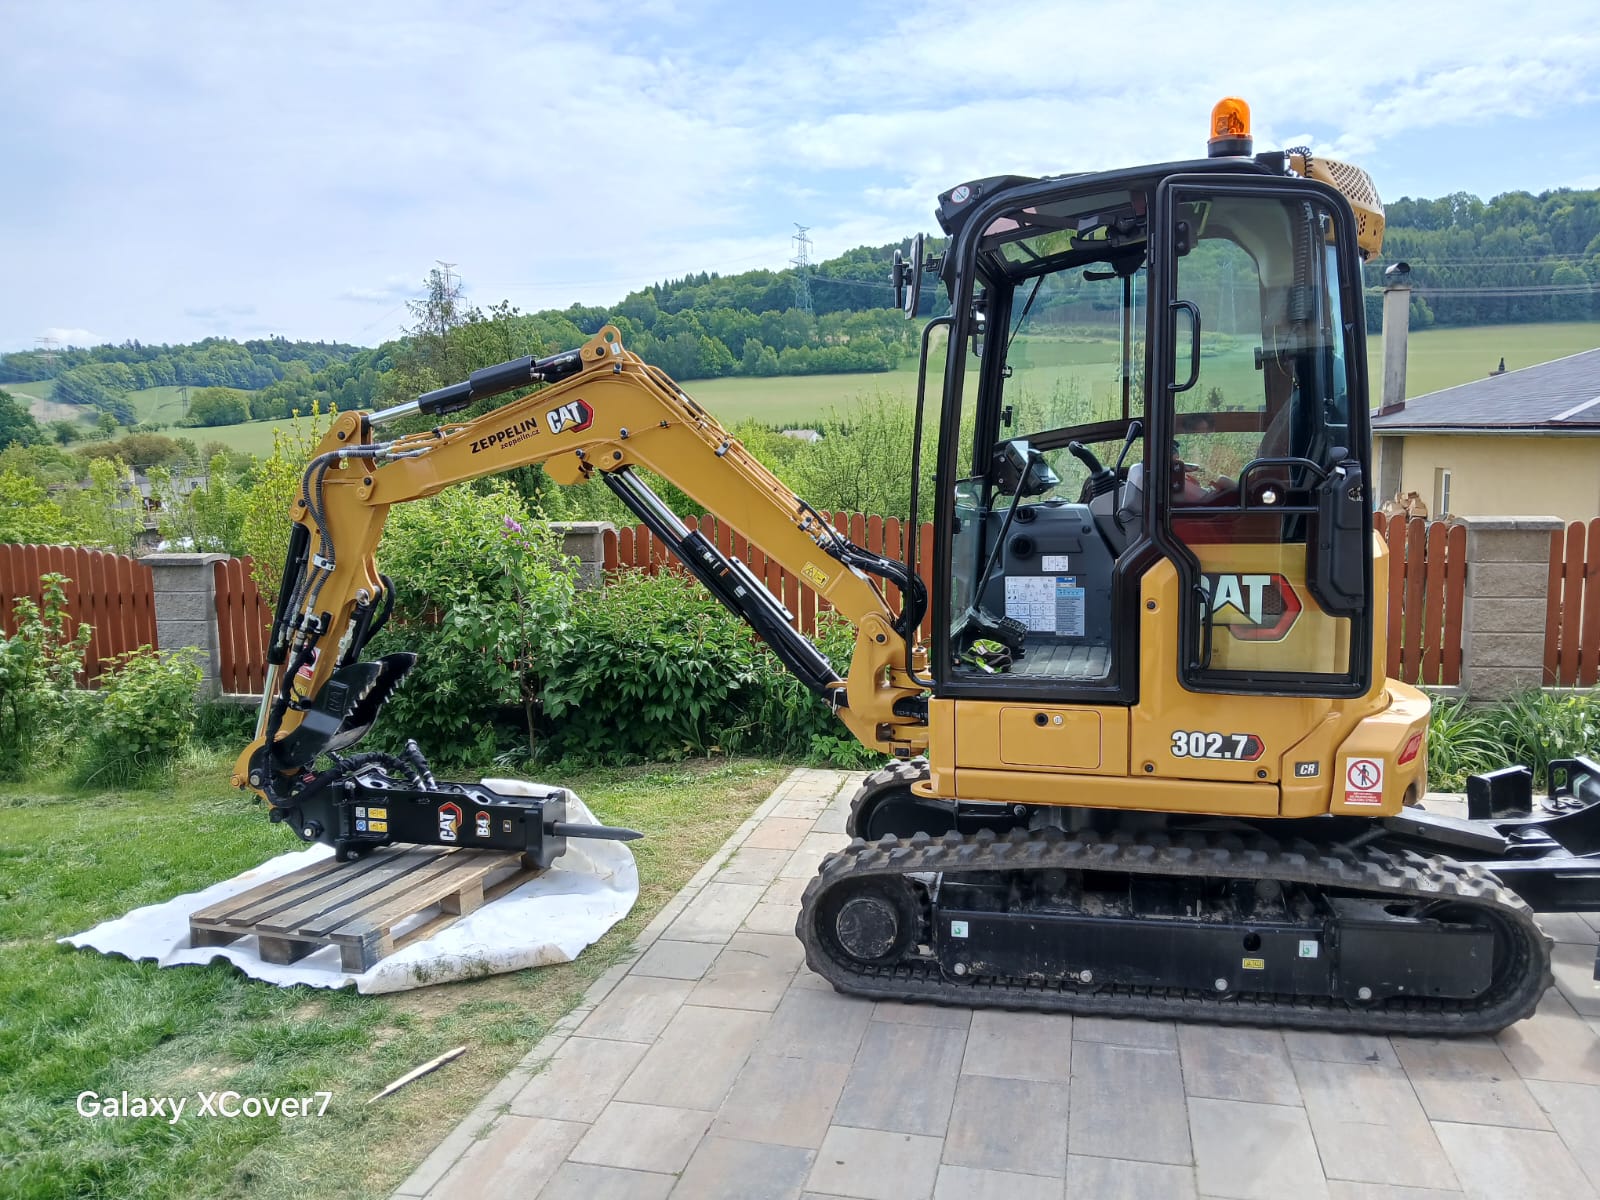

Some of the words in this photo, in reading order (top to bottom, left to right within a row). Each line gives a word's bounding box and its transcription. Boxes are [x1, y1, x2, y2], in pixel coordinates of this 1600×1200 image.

[546, 401, 582, 434] CAT
[469, 417, 538, 454] ZEPPELIN
[500, 429, 541, 449] zeppelin.cz
[1171, 731, 1249, 760] 302.7
[1299, 764, 1316, 775] CR
[439, 811, 457, 841] CAT
